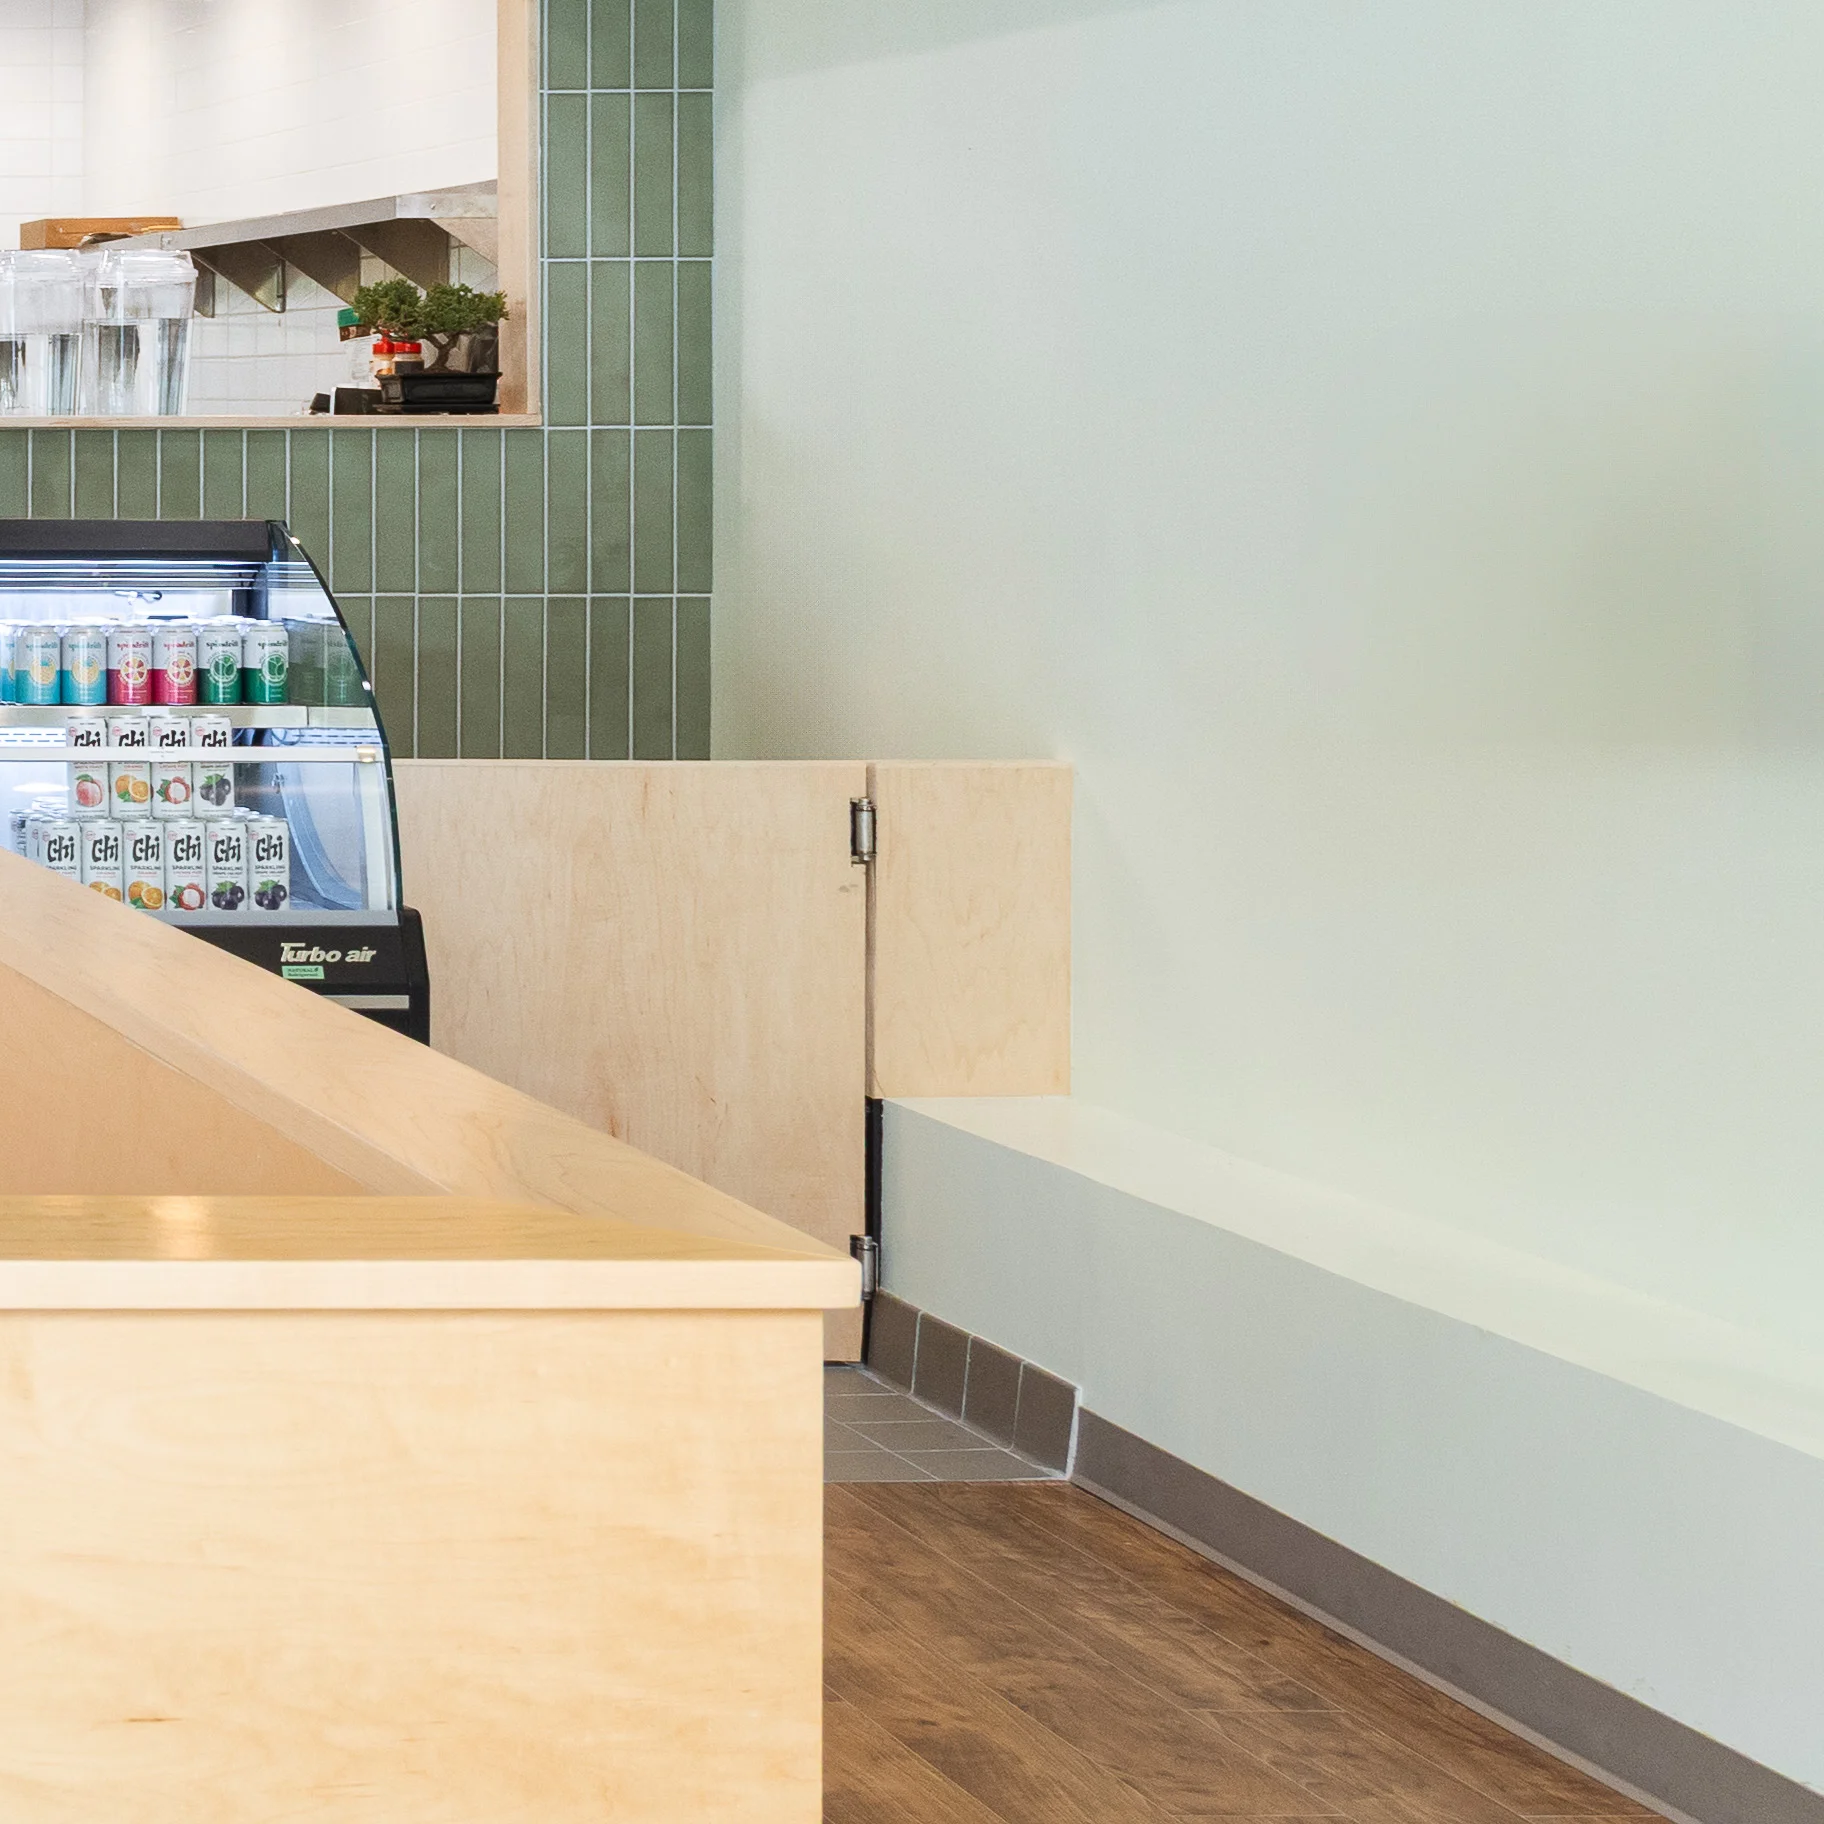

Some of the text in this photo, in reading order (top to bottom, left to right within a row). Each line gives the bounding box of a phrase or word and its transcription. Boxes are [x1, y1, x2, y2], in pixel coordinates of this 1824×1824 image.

[48, 835, 74, 862] Chi
[92, 835, 118, 862] Chi
[133, 835, 160, 862] Chi
[174, 835, 200, 862] Chi
[214, 836, 240, 863] Chi
[256, 834, 282, 862] Chi
[280, 942, 377, 963] Turbo air
